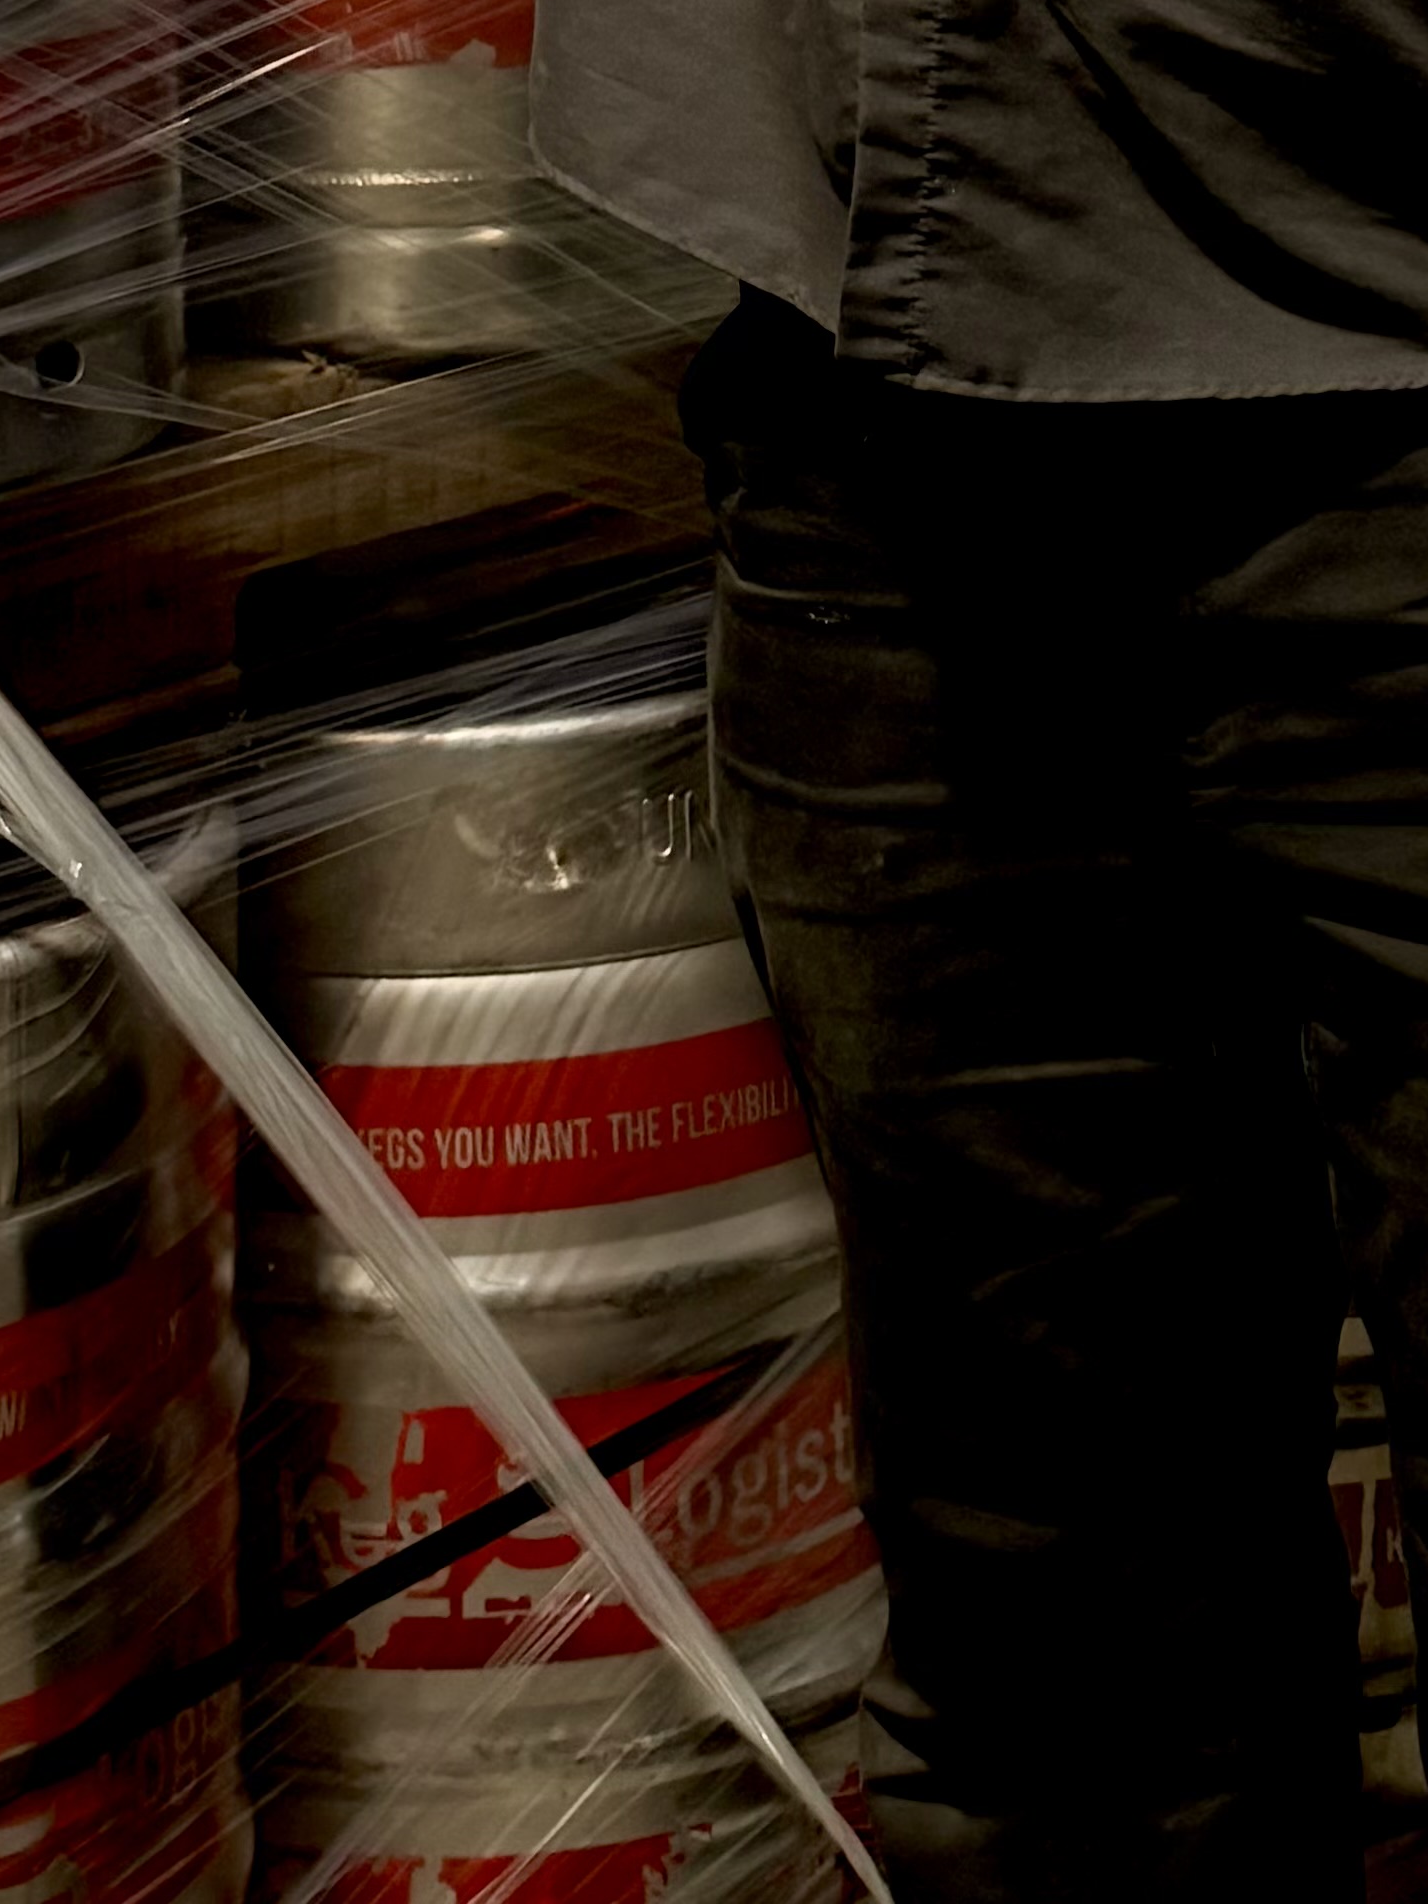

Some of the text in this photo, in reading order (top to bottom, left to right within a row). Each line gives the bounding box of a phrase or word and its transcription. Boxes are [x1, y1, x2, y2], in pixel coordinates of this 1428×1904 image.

[433, 1124, 496, 1171] YOU
[504, 1116, 599, 1167] WANT,
[606, 1105, 663, 1154] THE
